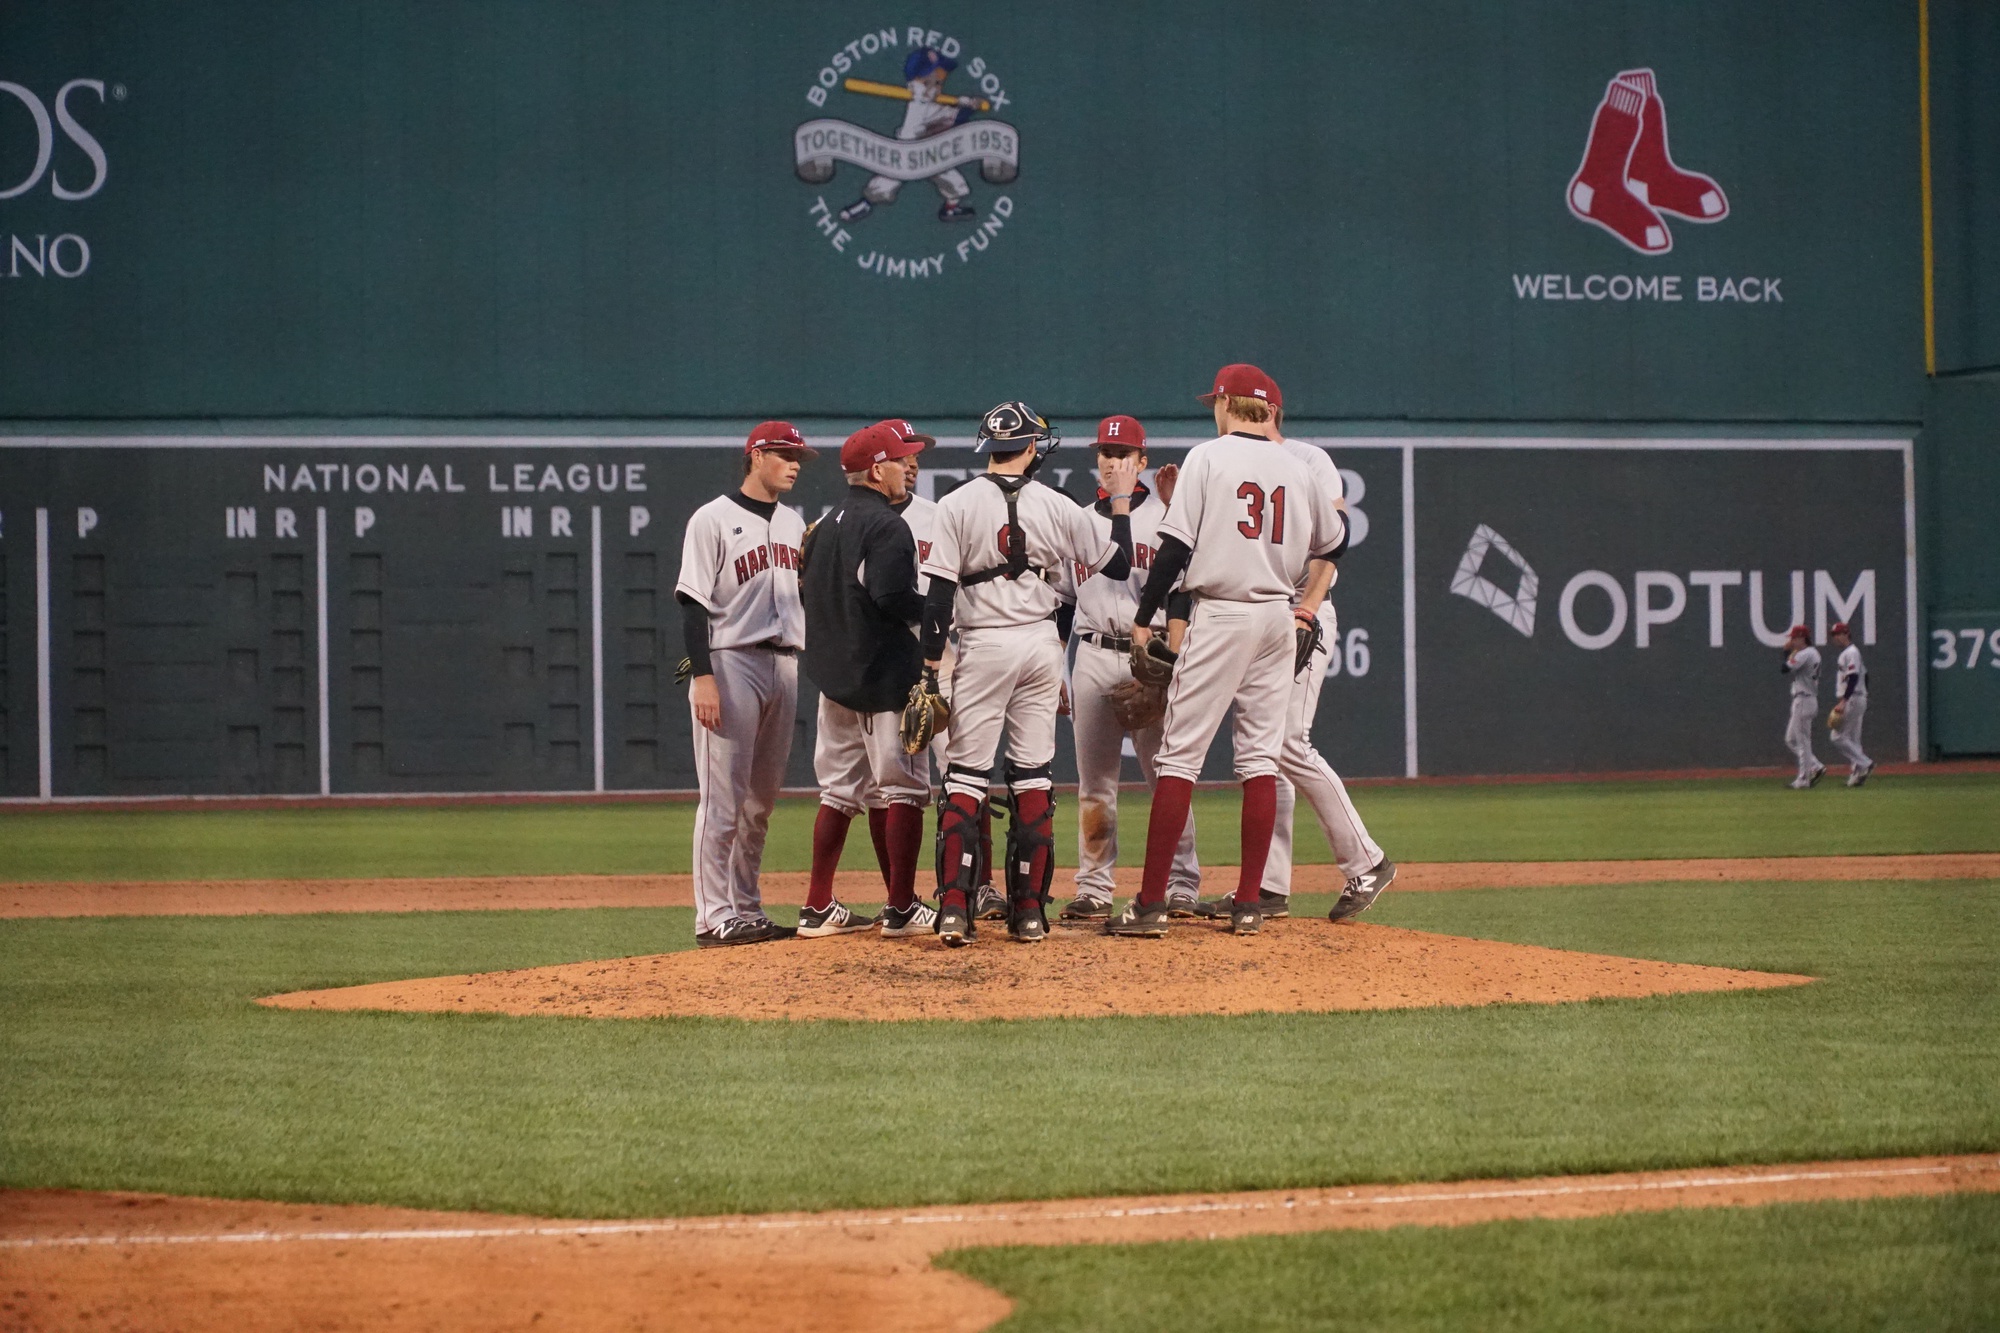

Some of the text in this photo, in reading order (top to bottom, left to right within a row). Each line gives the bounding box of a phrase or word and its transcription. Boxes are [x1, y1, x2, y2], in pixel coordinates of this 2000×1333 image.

[806, 26, 1011, 112] BOSTON RED SOX
[801, 130, 1013, 170] TOGETHER SINCE 1953
[809, 196, 1013, 278] THE JIMMY FUND
[0, 233, 90, 278] NO
[1512, 274, 1783, 302] WELCOME BACK
[1108, 422, 1120, 436] H
[264, 463, 647, 492] NATIONAL LEAGUE
[77, 507, 98, 538] P
[226, 507, 298, 538] IN R
[355, 507, 376, 538] P
[502, 506, 573, 537] IN R
[629, 506, 650, 537] P
[1237, 481, 1285, 545] 31
[1558, 569, 1876, 650] OPTUM
